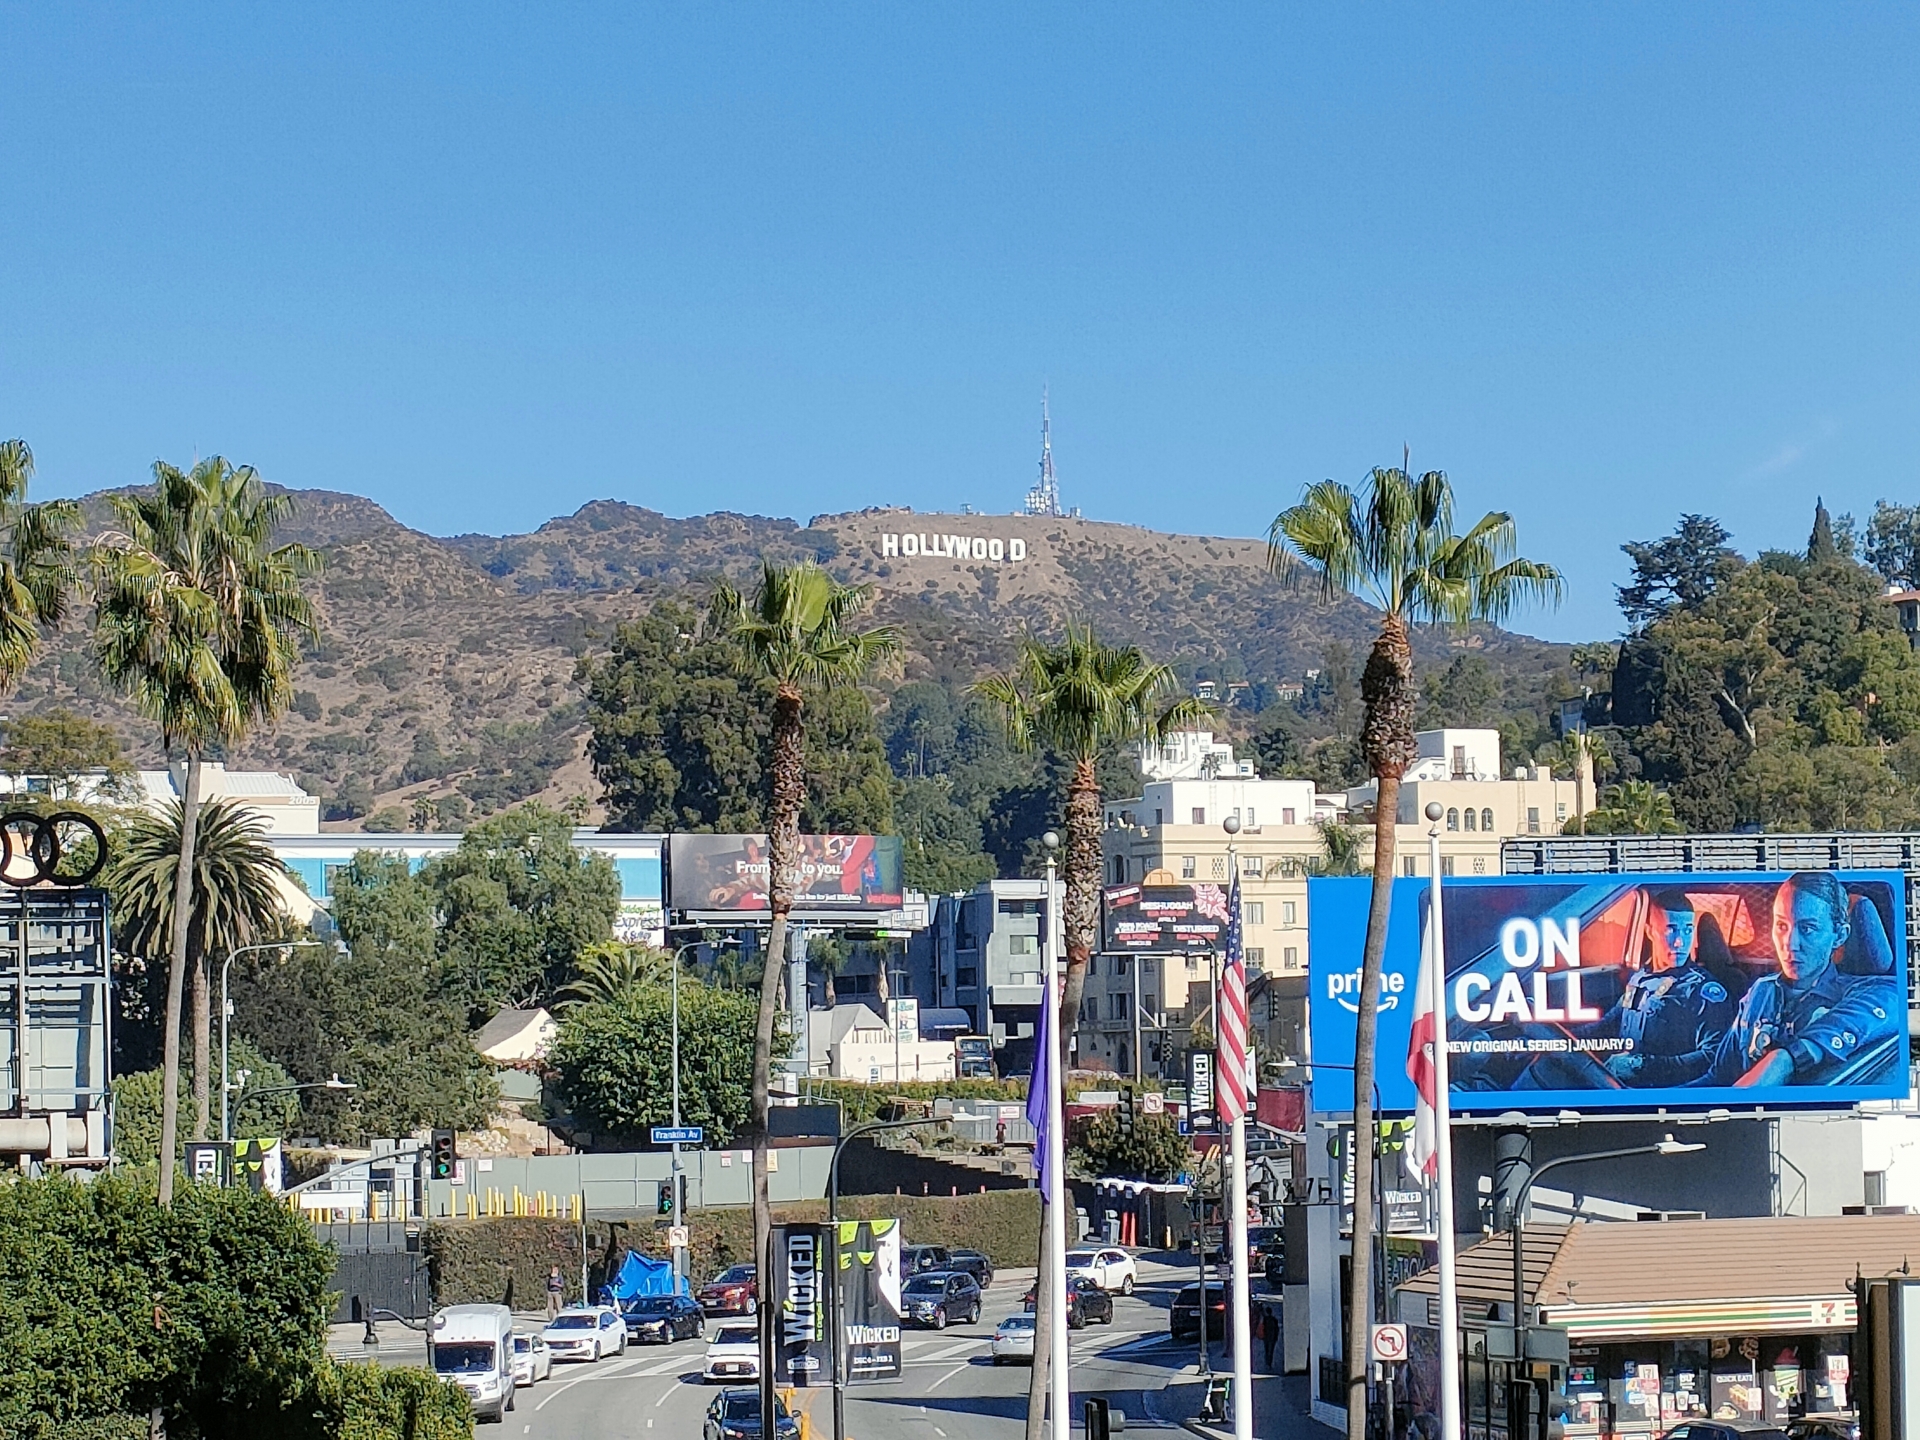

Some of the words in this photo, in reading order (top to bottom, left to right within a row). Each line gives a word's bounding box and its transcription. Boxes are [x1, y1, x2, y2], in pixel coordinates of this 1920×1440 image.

[882, 533, 1026, 561] HOLLYWOOD
[736, 860, 770, 874] From
[801, 862, 815, 874] to
[817, 864, 843, 877] you.
[1503, 917, 1581, 967] ON
[1455, 972, 1600, 1022] CALL
[1446, 1041, 1473, 1053] NEW
[1473, 1040, 1527, 1053] ORIGINAL
[1528, 1039, 1569, 1051] SERIES
[1573, 1038, 1625, 1050] JANUARY
[1625, 1037, 1634, 1049] 9
[655, 1131, 687, 1139] Franklin
[688, 1130, 699, 1138] Av
